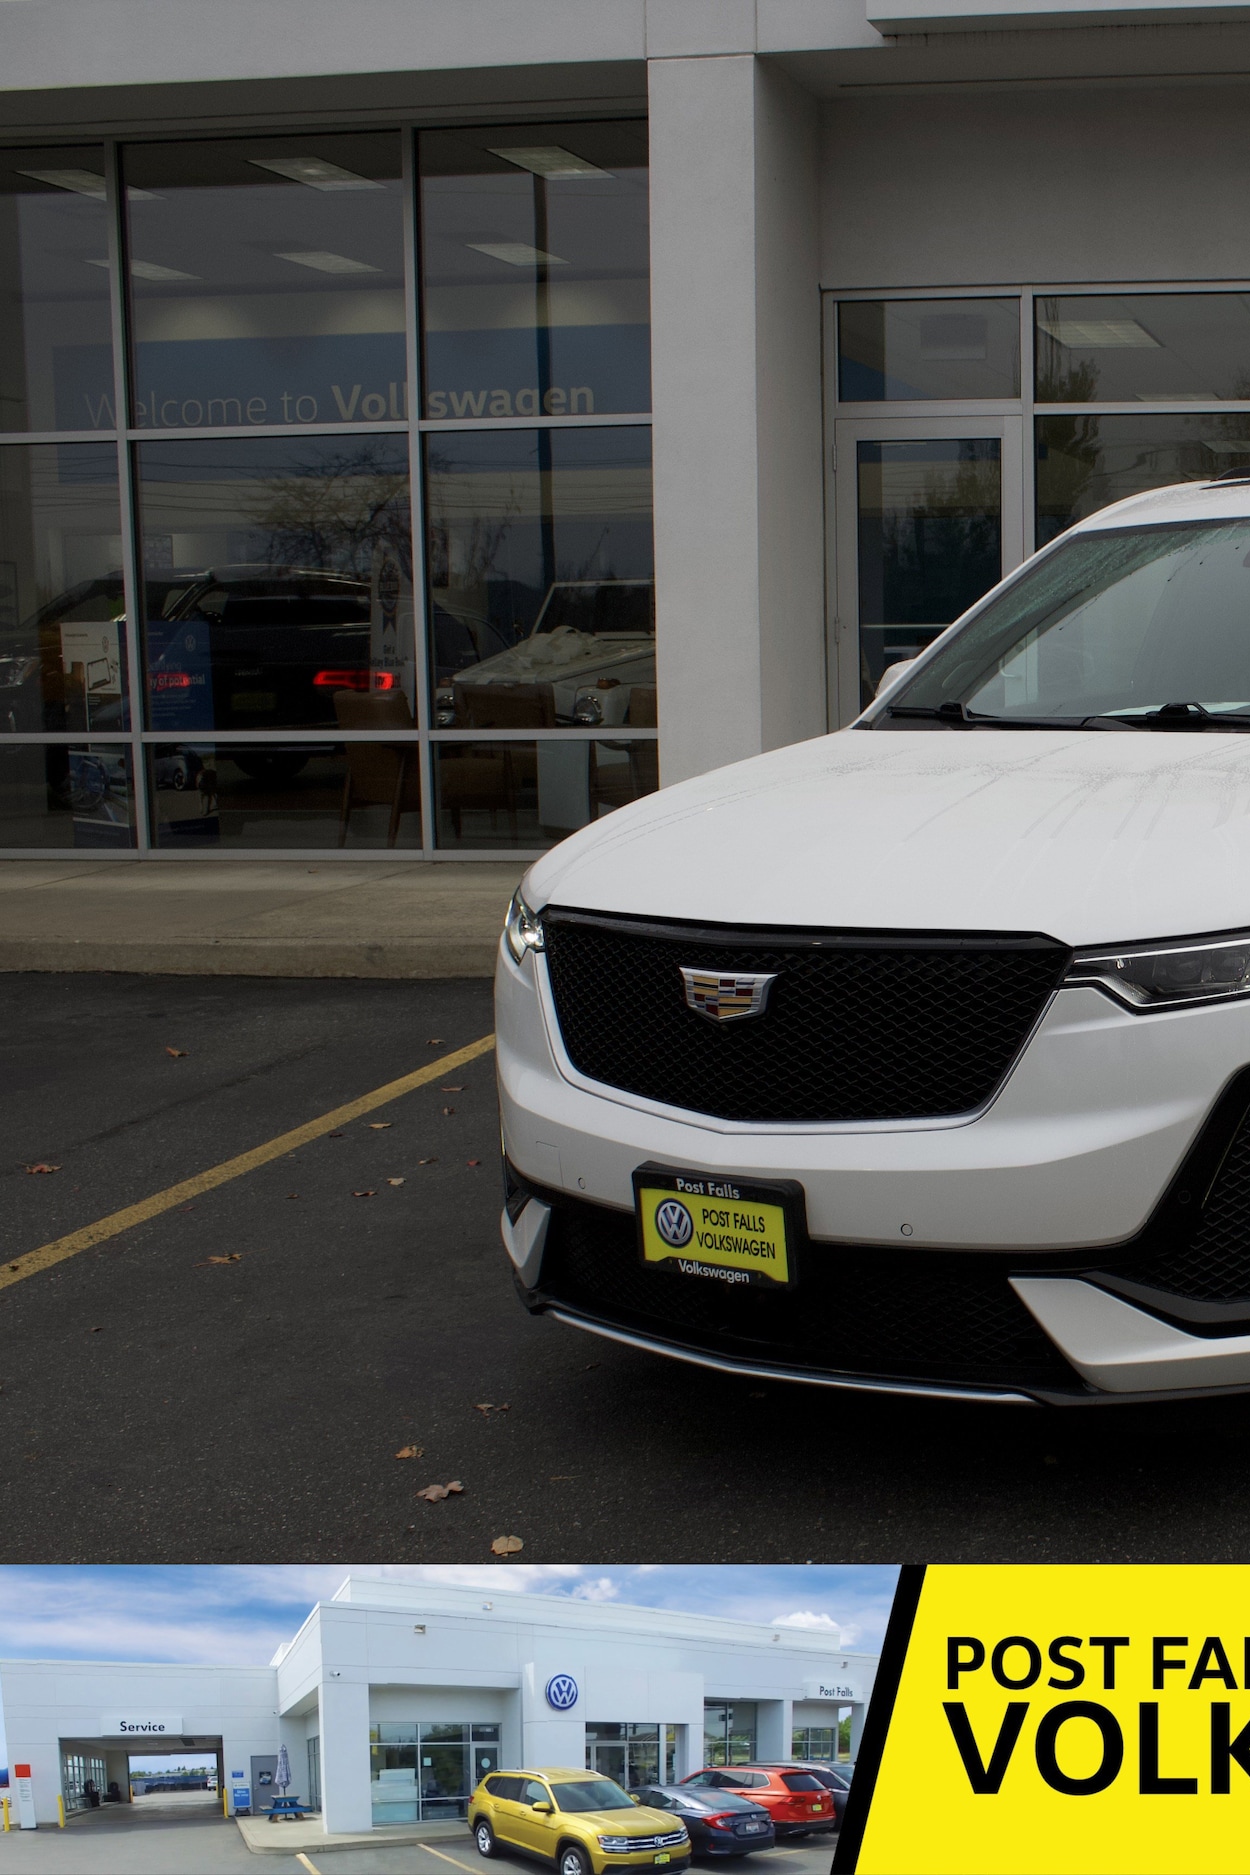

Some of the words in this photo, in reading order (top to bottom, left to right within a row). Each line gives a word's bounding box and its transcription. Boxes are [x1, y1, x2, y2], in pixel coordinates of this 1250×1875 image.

[83, 391, 267, 429] Welcome
[280, 391, 318, 424] to
[676, 1178, 705, 1194] Post
[708, 1182, 740, 1199] Falls
[702, 1208, 730, 1228] POST
[733, 1213, 765, 1232] FALLS
[696, 1231, 776, 1259] VOLKSWAGEN
[678, 1259, 750, 1283] Volkswagen
